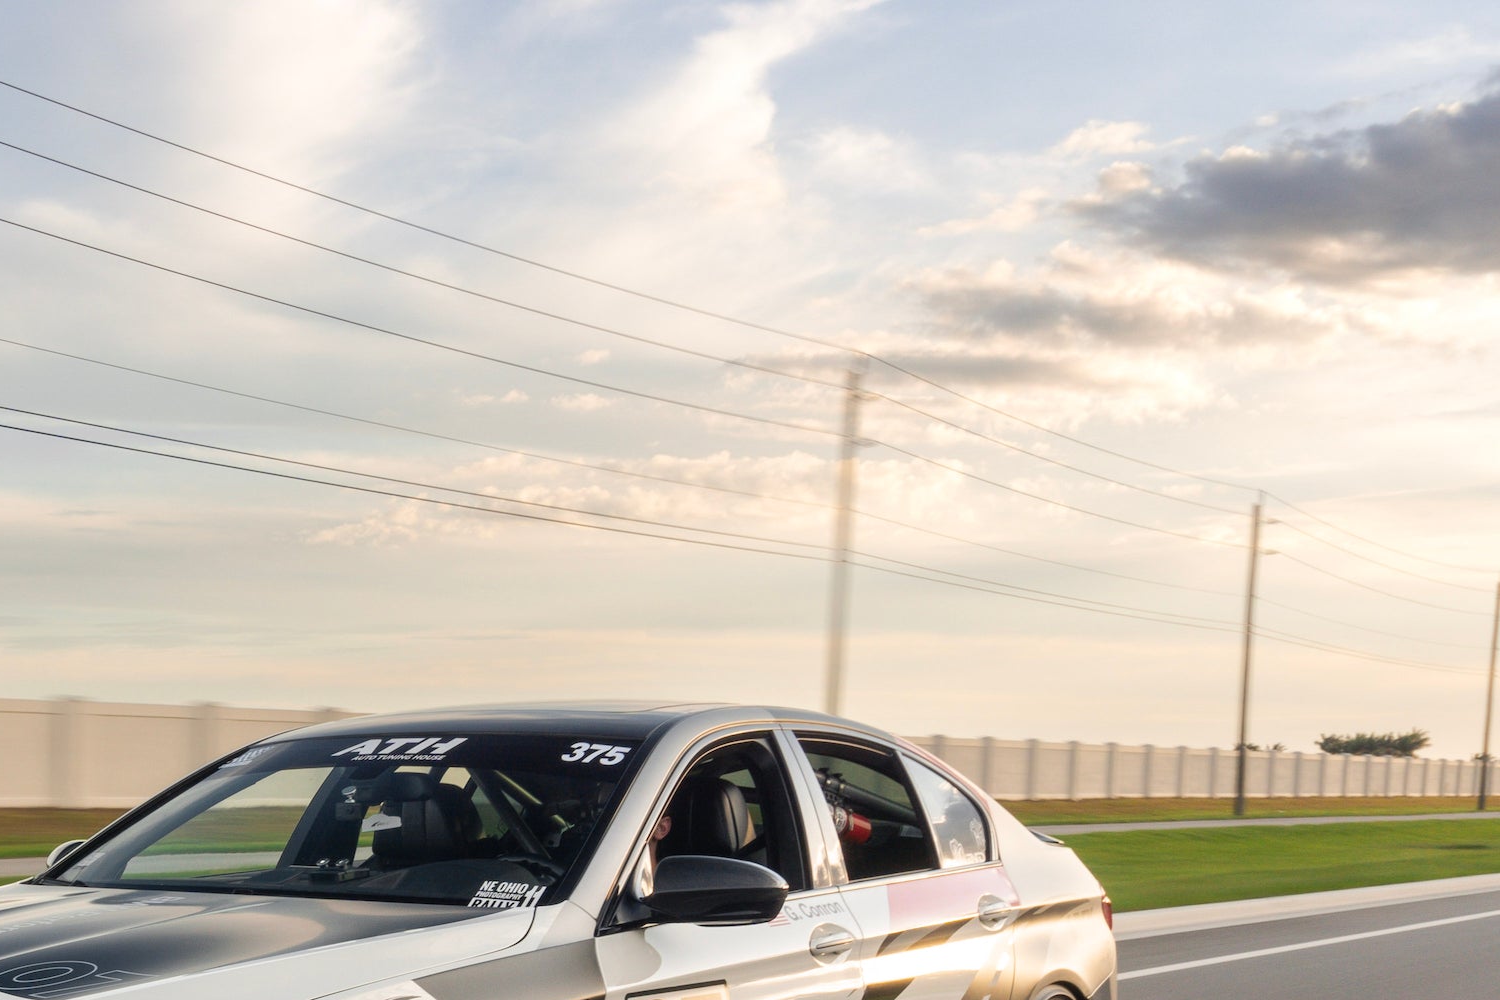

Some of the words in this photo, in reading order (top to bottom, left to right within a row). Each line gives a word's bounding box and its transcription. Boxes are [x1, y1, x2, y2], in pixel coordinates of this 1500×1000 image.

[331, 737, 468, 757] ATH
[561, 742, 632, 766] 375
[350, 753, 378, 761] AUTO
[479, 880, 499, 892] NE
[496, 881, 530, 895] OHIO
[474, 891, 525, 901] PHOTOGRAPHY
[784, 905, 803, 922] G.
